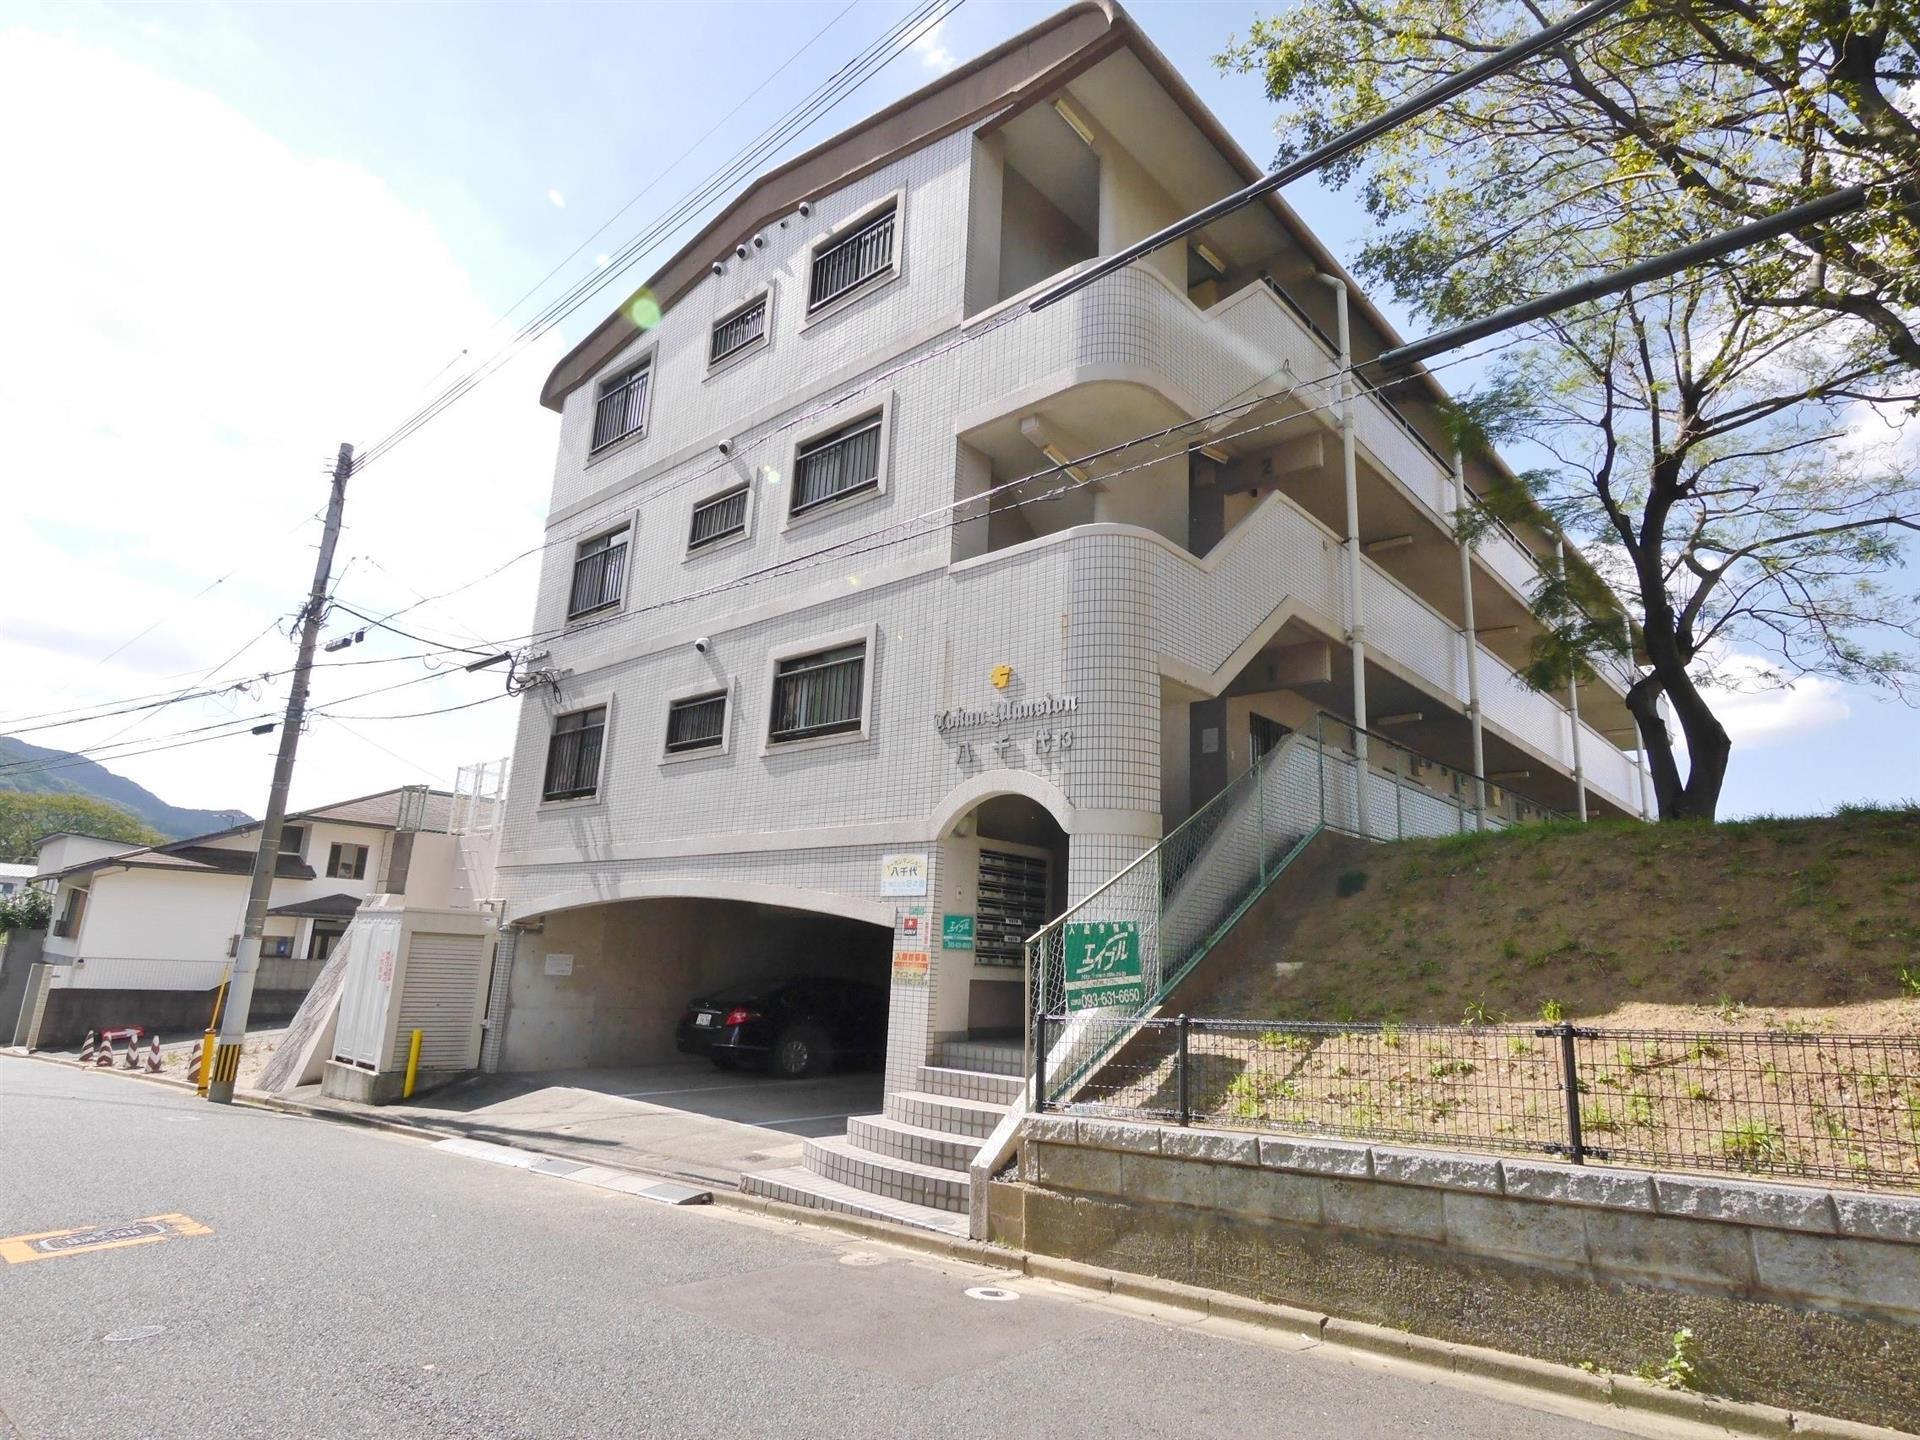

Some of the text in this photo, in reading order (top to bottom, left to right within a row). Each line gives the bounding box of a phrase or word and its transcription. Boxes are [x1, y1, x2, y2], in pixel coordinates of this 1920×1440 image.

[890, 866, 918, 877] 八千代
[1077, 932, 1128, 974] エイブル
